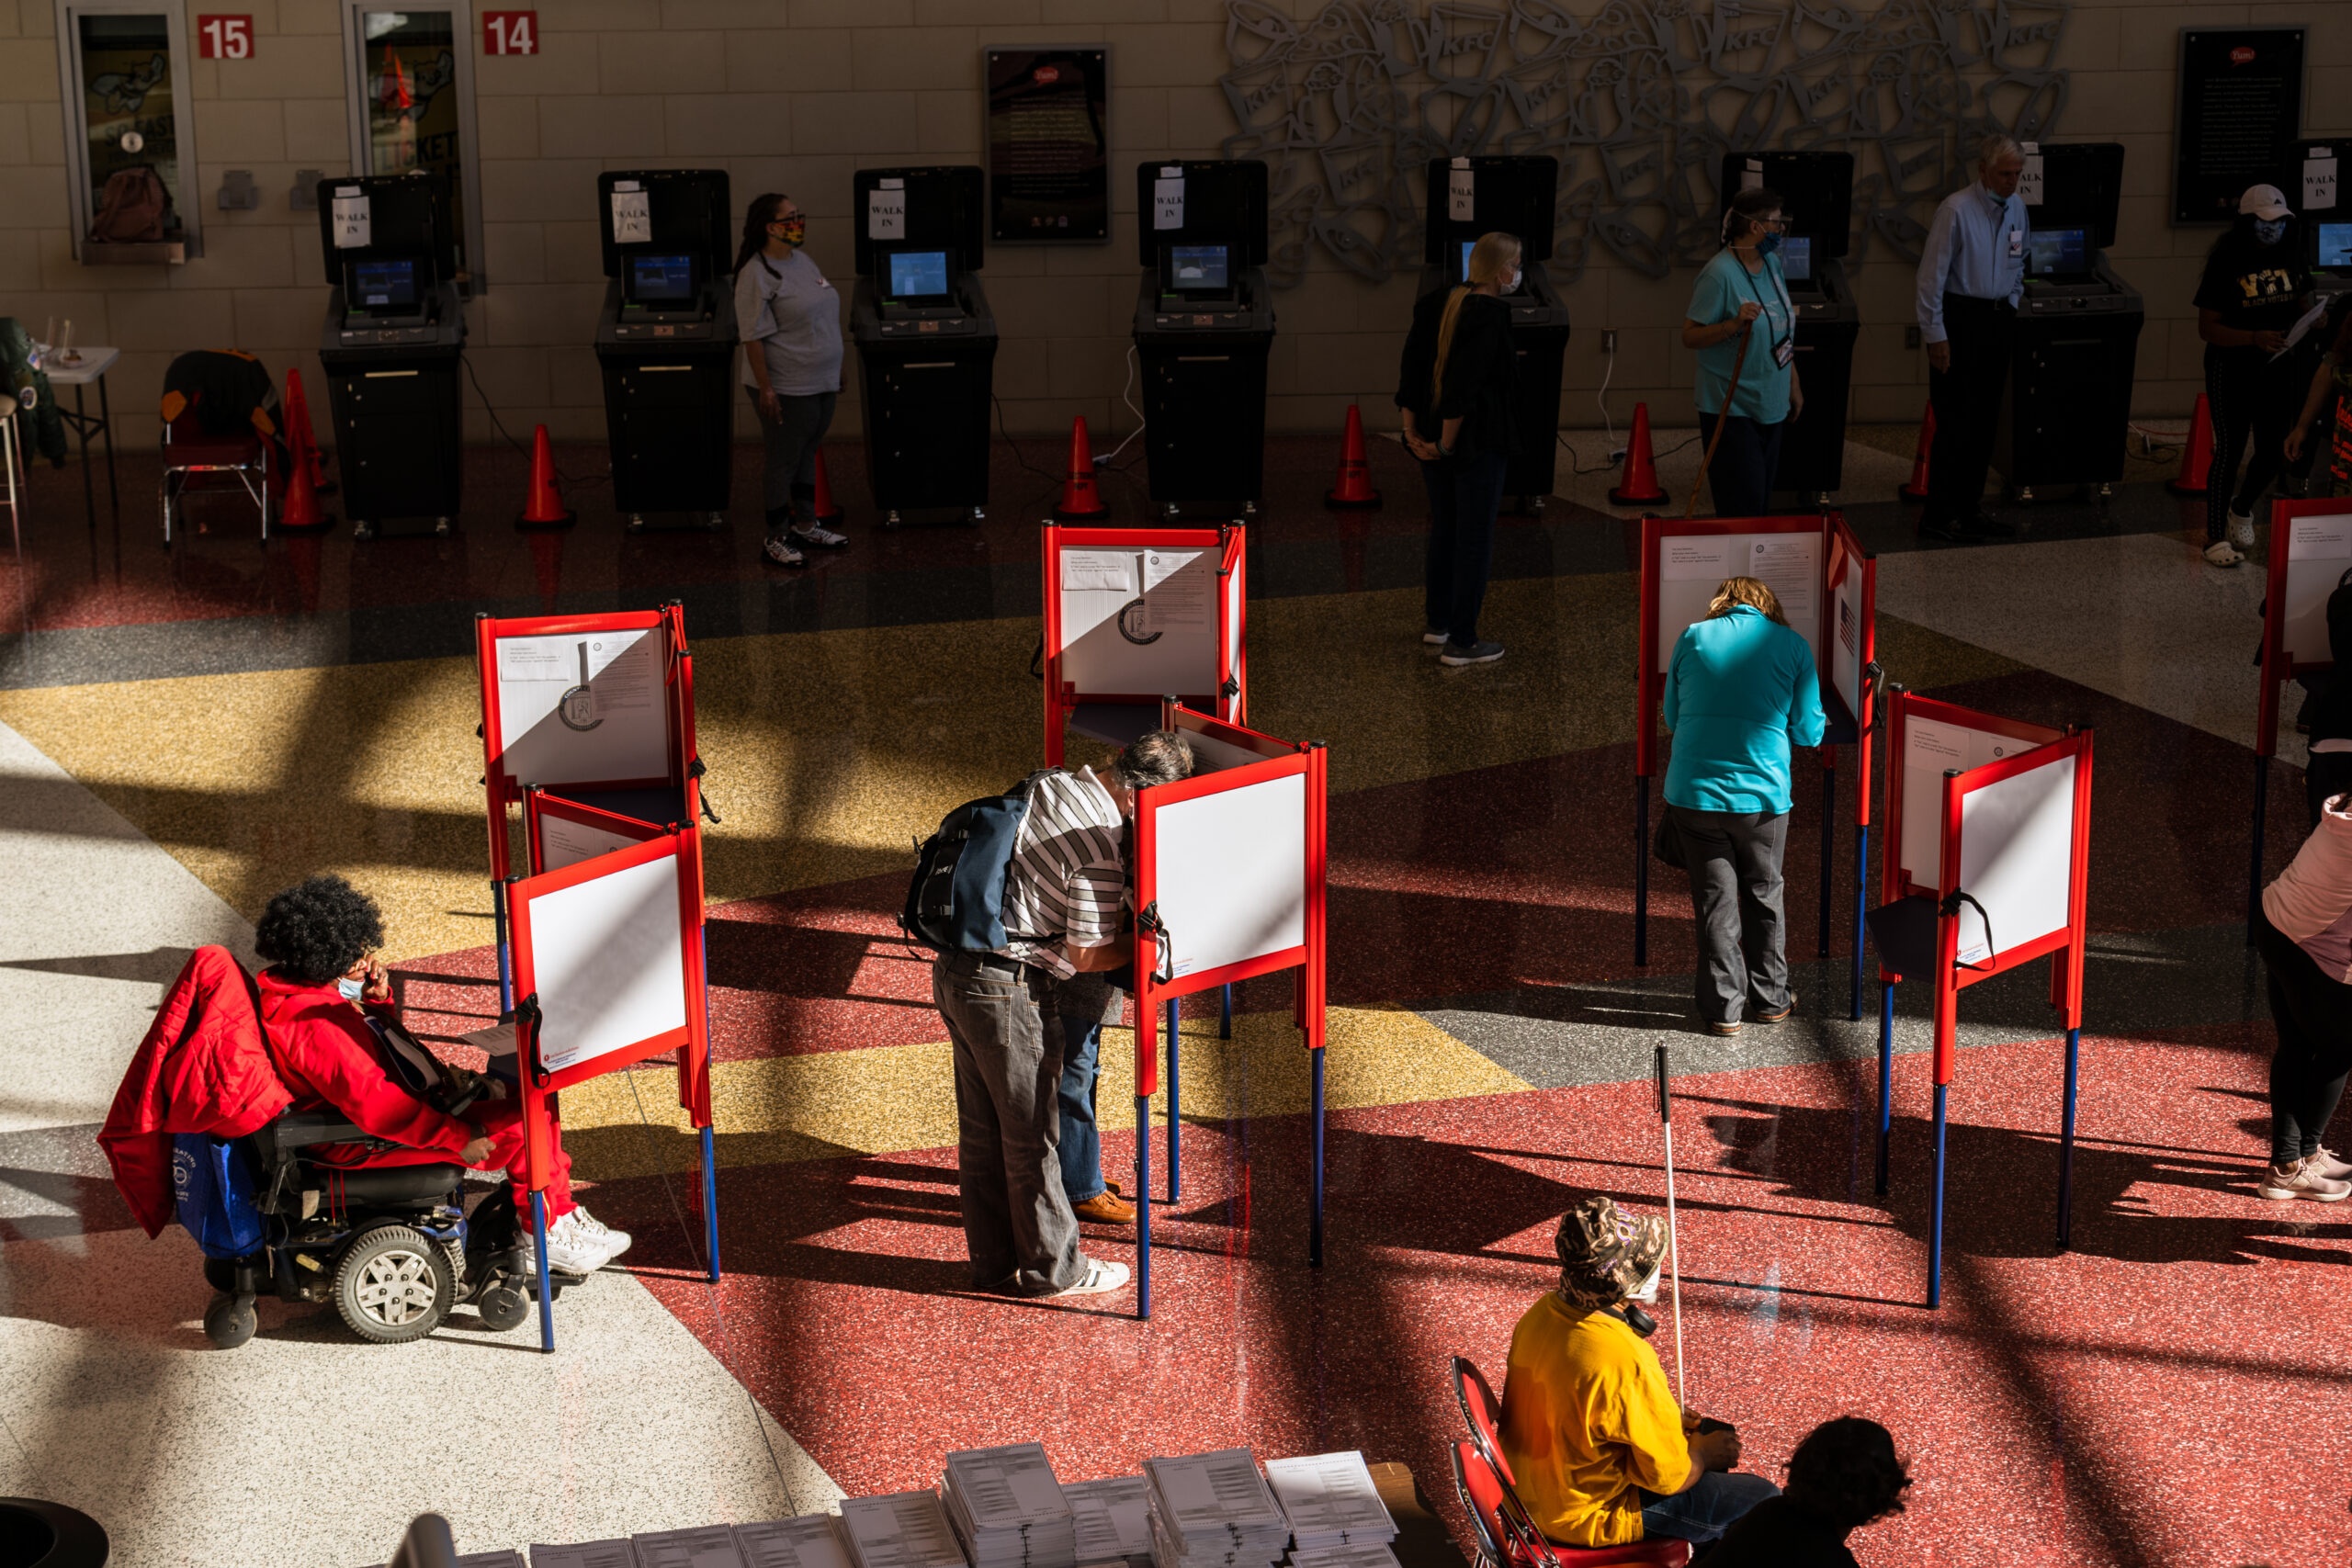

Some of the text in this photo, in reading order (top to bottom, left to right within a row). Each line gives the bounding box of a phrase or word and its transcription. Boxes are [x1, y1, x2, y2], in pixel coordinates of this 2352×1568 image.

[488, 17, 534, 55] 14
[2007, 20, 2059, 46] KFC
[203, 19, 247, 59] 15
[1442, 31, 1495, 57] KFC
[1725, 28, 1778, 51] KFC
[2233, 50, 2256, 60] Yum!
[1036, 70, 1058, 81] Yum!
[1244, 74, 1286, 116] KFC
[1527, 71, 1566, 111] KFC
[2020, 174, 2041, 182] ALK
[2305, 175, 2335, 185] WALK
[1451, 187, 1473, 197] WALK
[2020, 186, 2031, 194] IN
[2315, 188, 2325, 197] IN
[1157, 197, 1183, 205] WALK
[1456, 200, 1465, 209] IN
[616, 209, 648, 219] WALK
[872, 206, 904, 215] WALK
[1165, 209, 1176, 218] IN
[335, 212, 368, 222] WALK
[627, 222, 639, 231] IN
[881, 219, 893, 227] IN
[346, 225, 358, 234] IN
